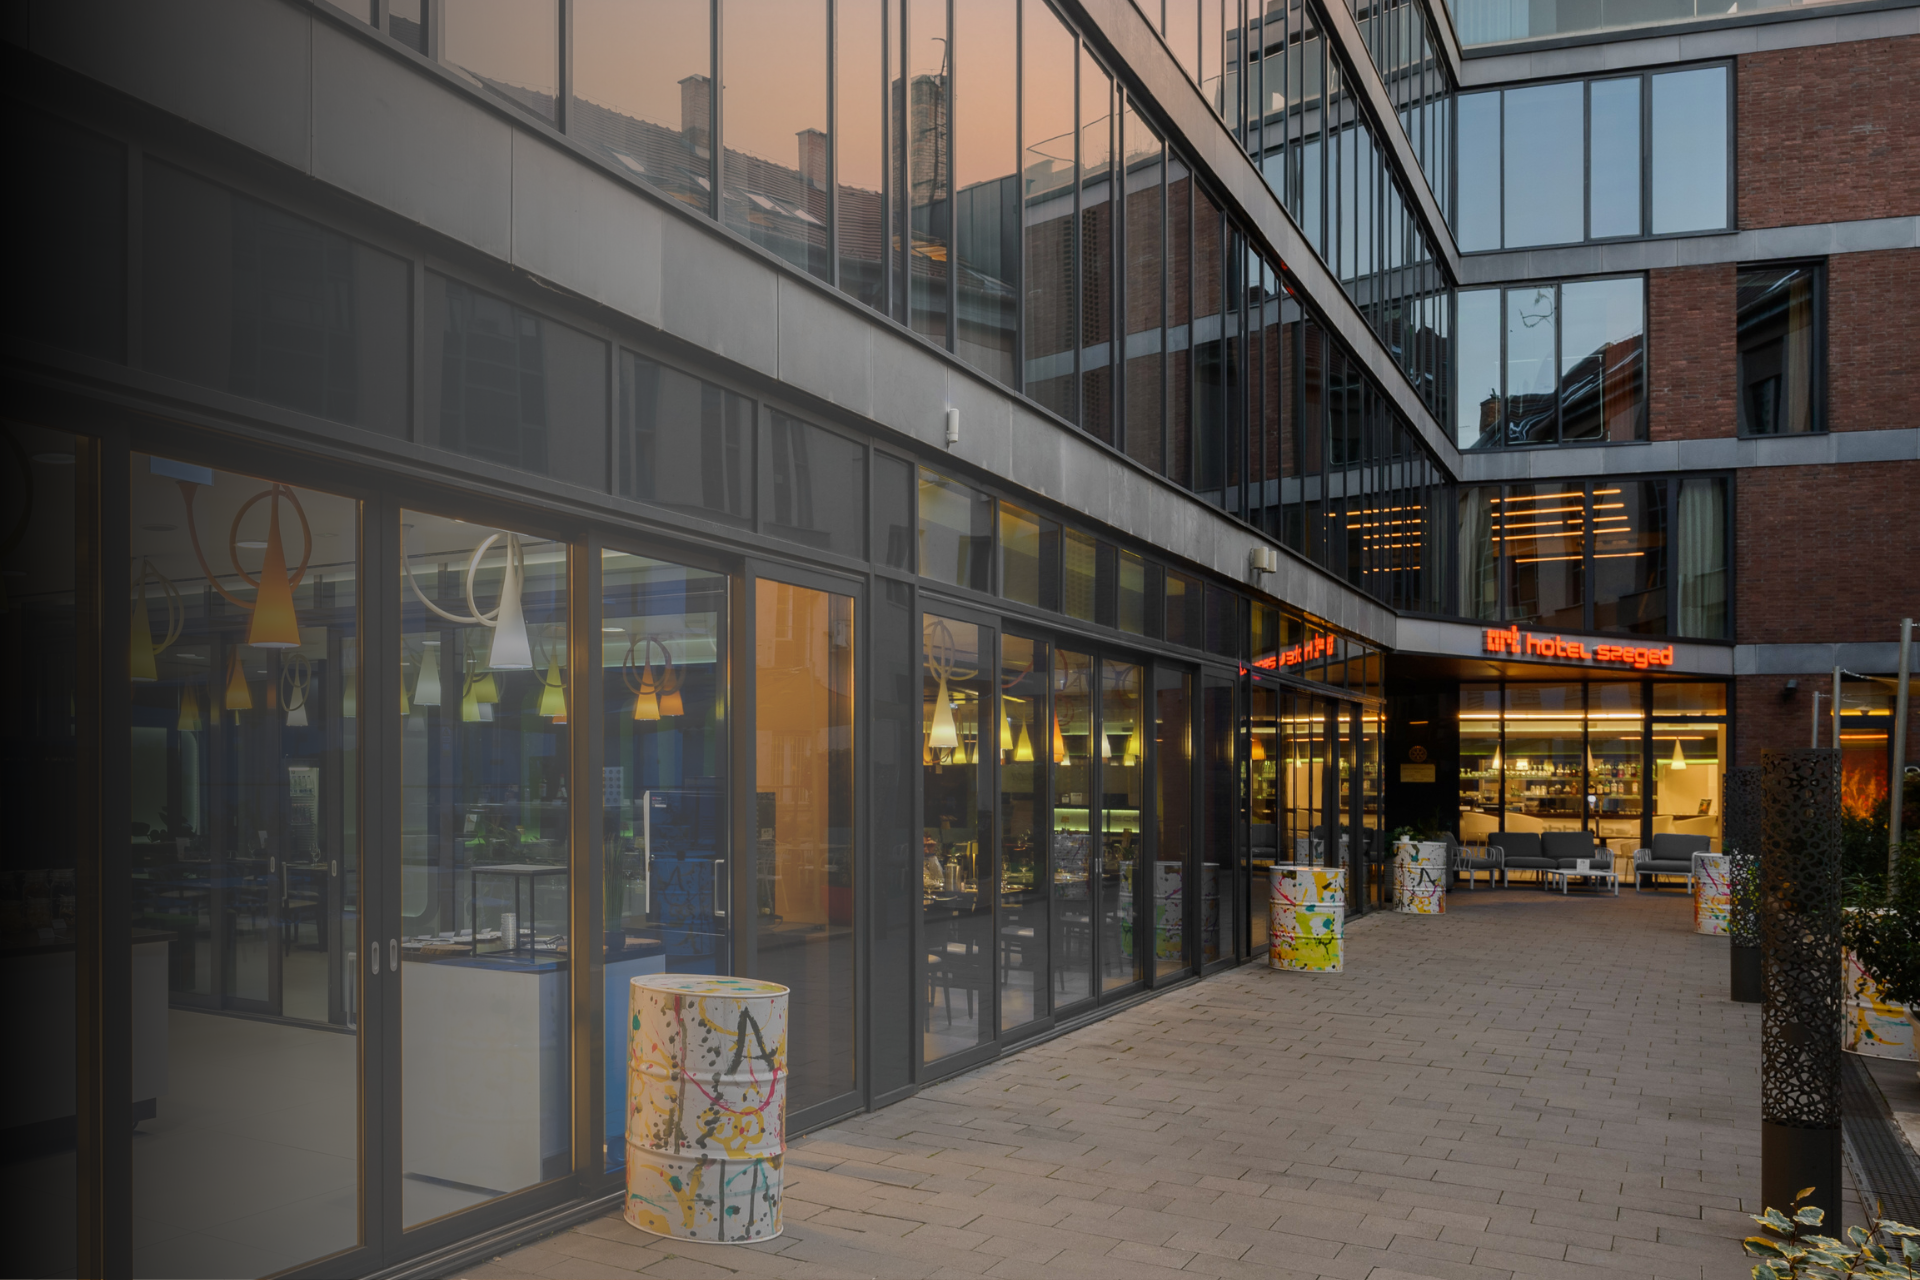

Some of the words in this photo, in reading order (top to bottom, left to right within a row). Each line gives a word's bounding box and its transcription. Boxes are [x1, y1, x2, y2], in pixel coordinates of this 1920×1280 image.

[1485, 624, 1522, 654] art
[1525, 632, 1592, 660] hotel
[1595, 643, 1674, 669] szeged
